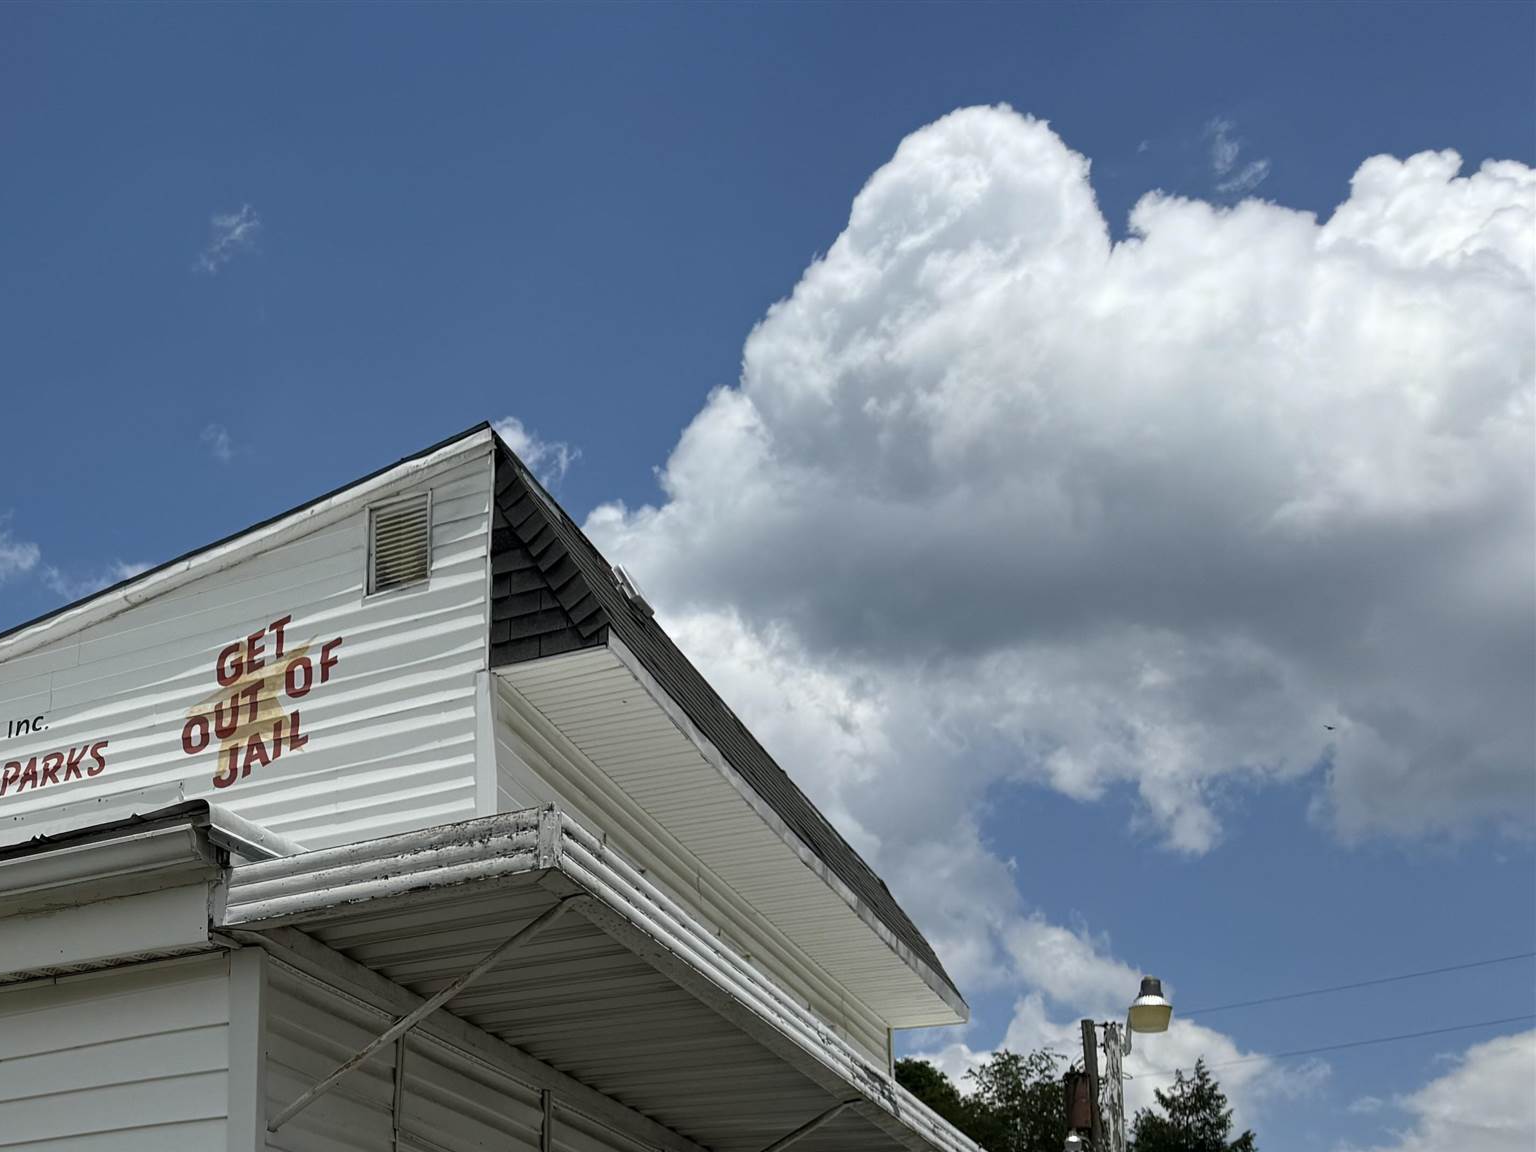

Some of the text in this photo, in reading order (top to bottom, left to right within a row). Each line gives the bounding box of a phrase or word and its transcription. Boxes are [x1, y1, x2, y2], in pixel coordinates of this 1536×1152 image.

[216, 614, 292, 687] GET
[7, 715, 49, 738] Inc.
[181, 636, 343, 754] OUT OF
[213, 709, 309, 789] JAIL
